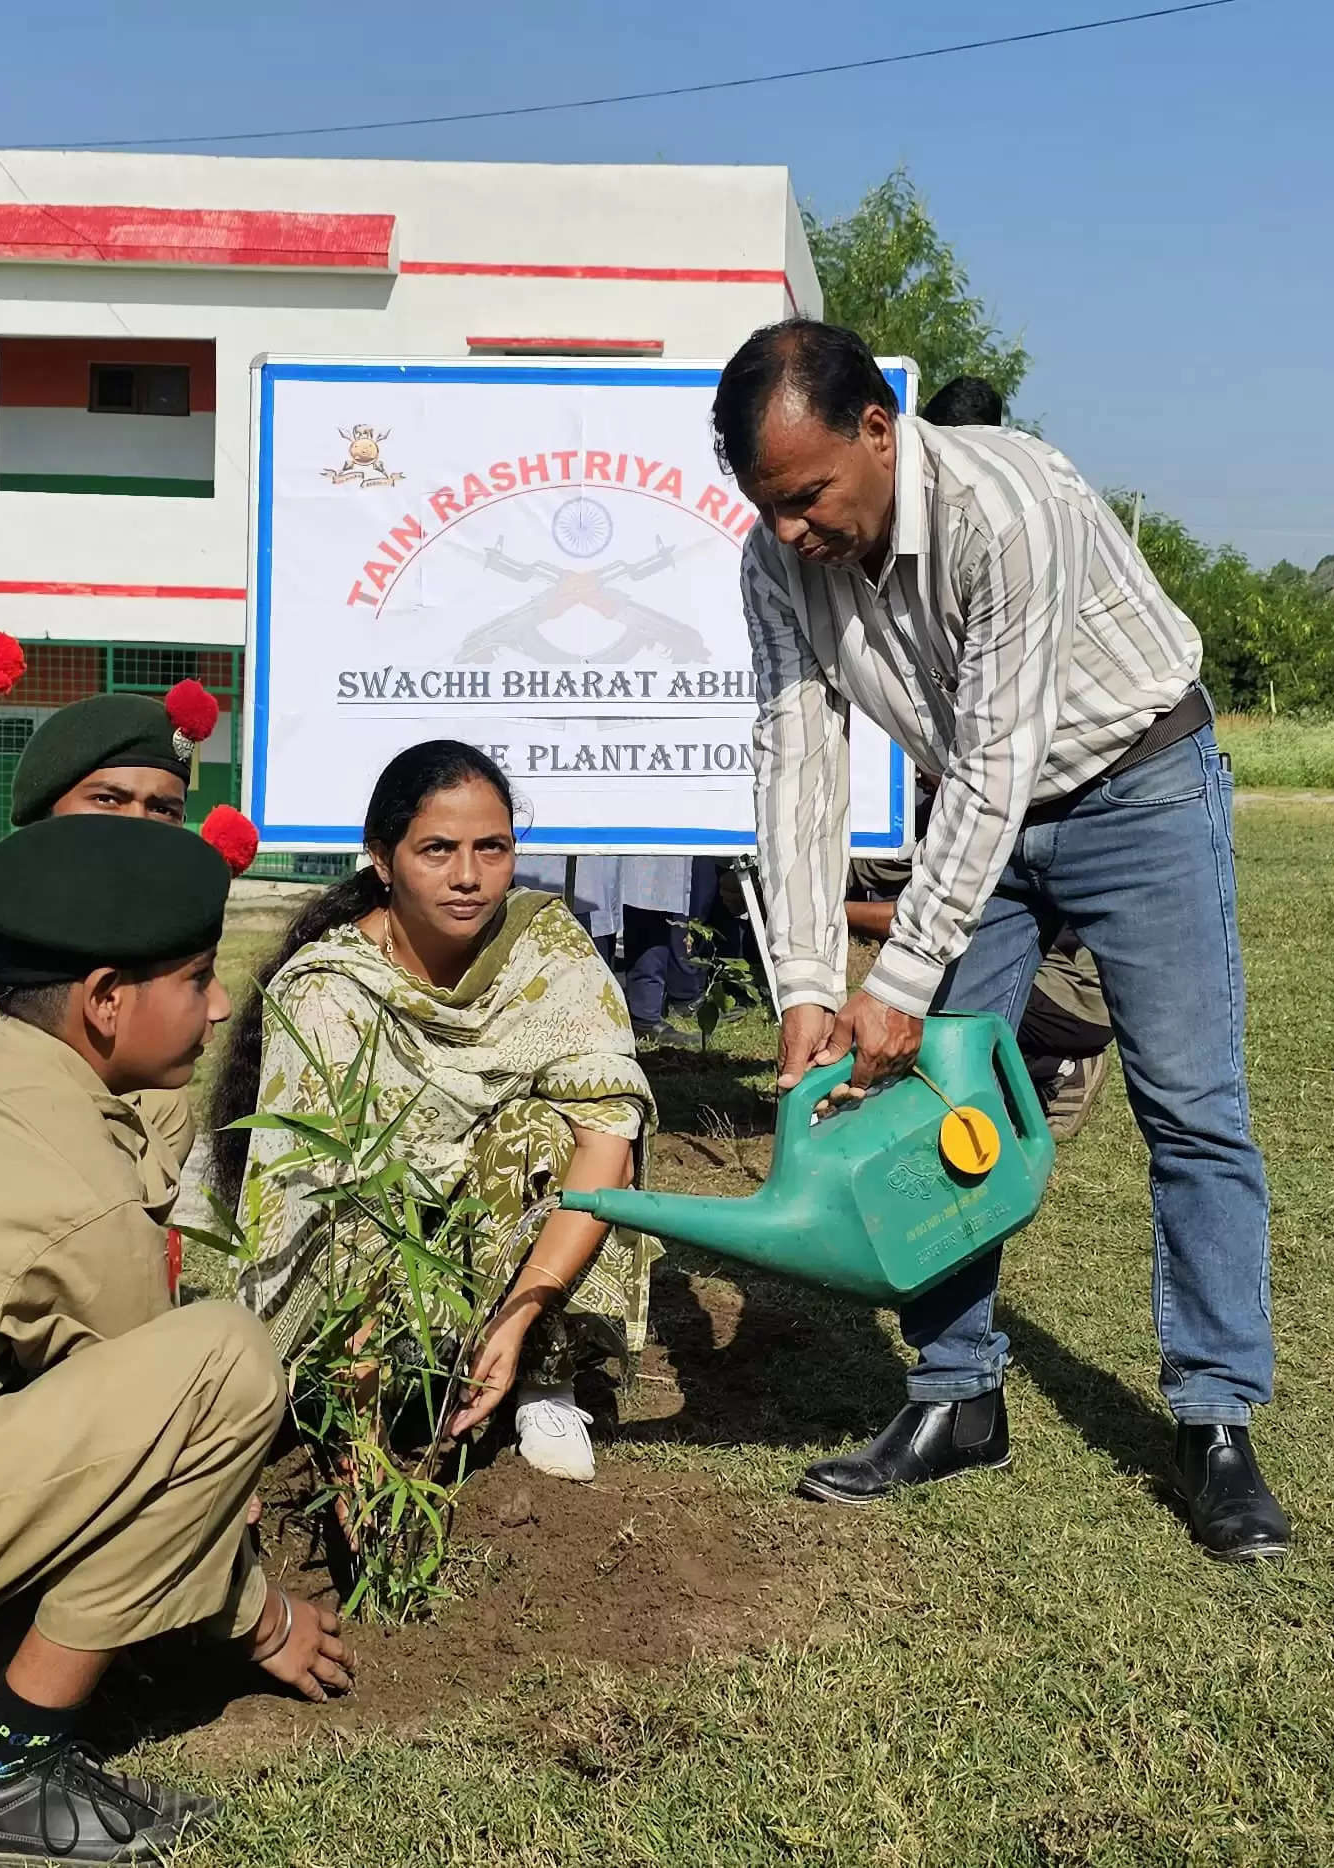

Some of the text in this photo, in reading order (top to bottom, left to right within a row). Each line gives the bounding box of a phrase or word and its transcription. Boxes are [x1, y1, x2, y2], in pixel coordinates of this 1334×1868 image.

[346, 513, 427, 607] TAIN
[428, 451, 683, 524] RASHTRIYA
[337, 665, 491, 698] SWACHH
[502, 671, 657, 698] BHARAT
[526, 744, 755, 771] PLANTATION
